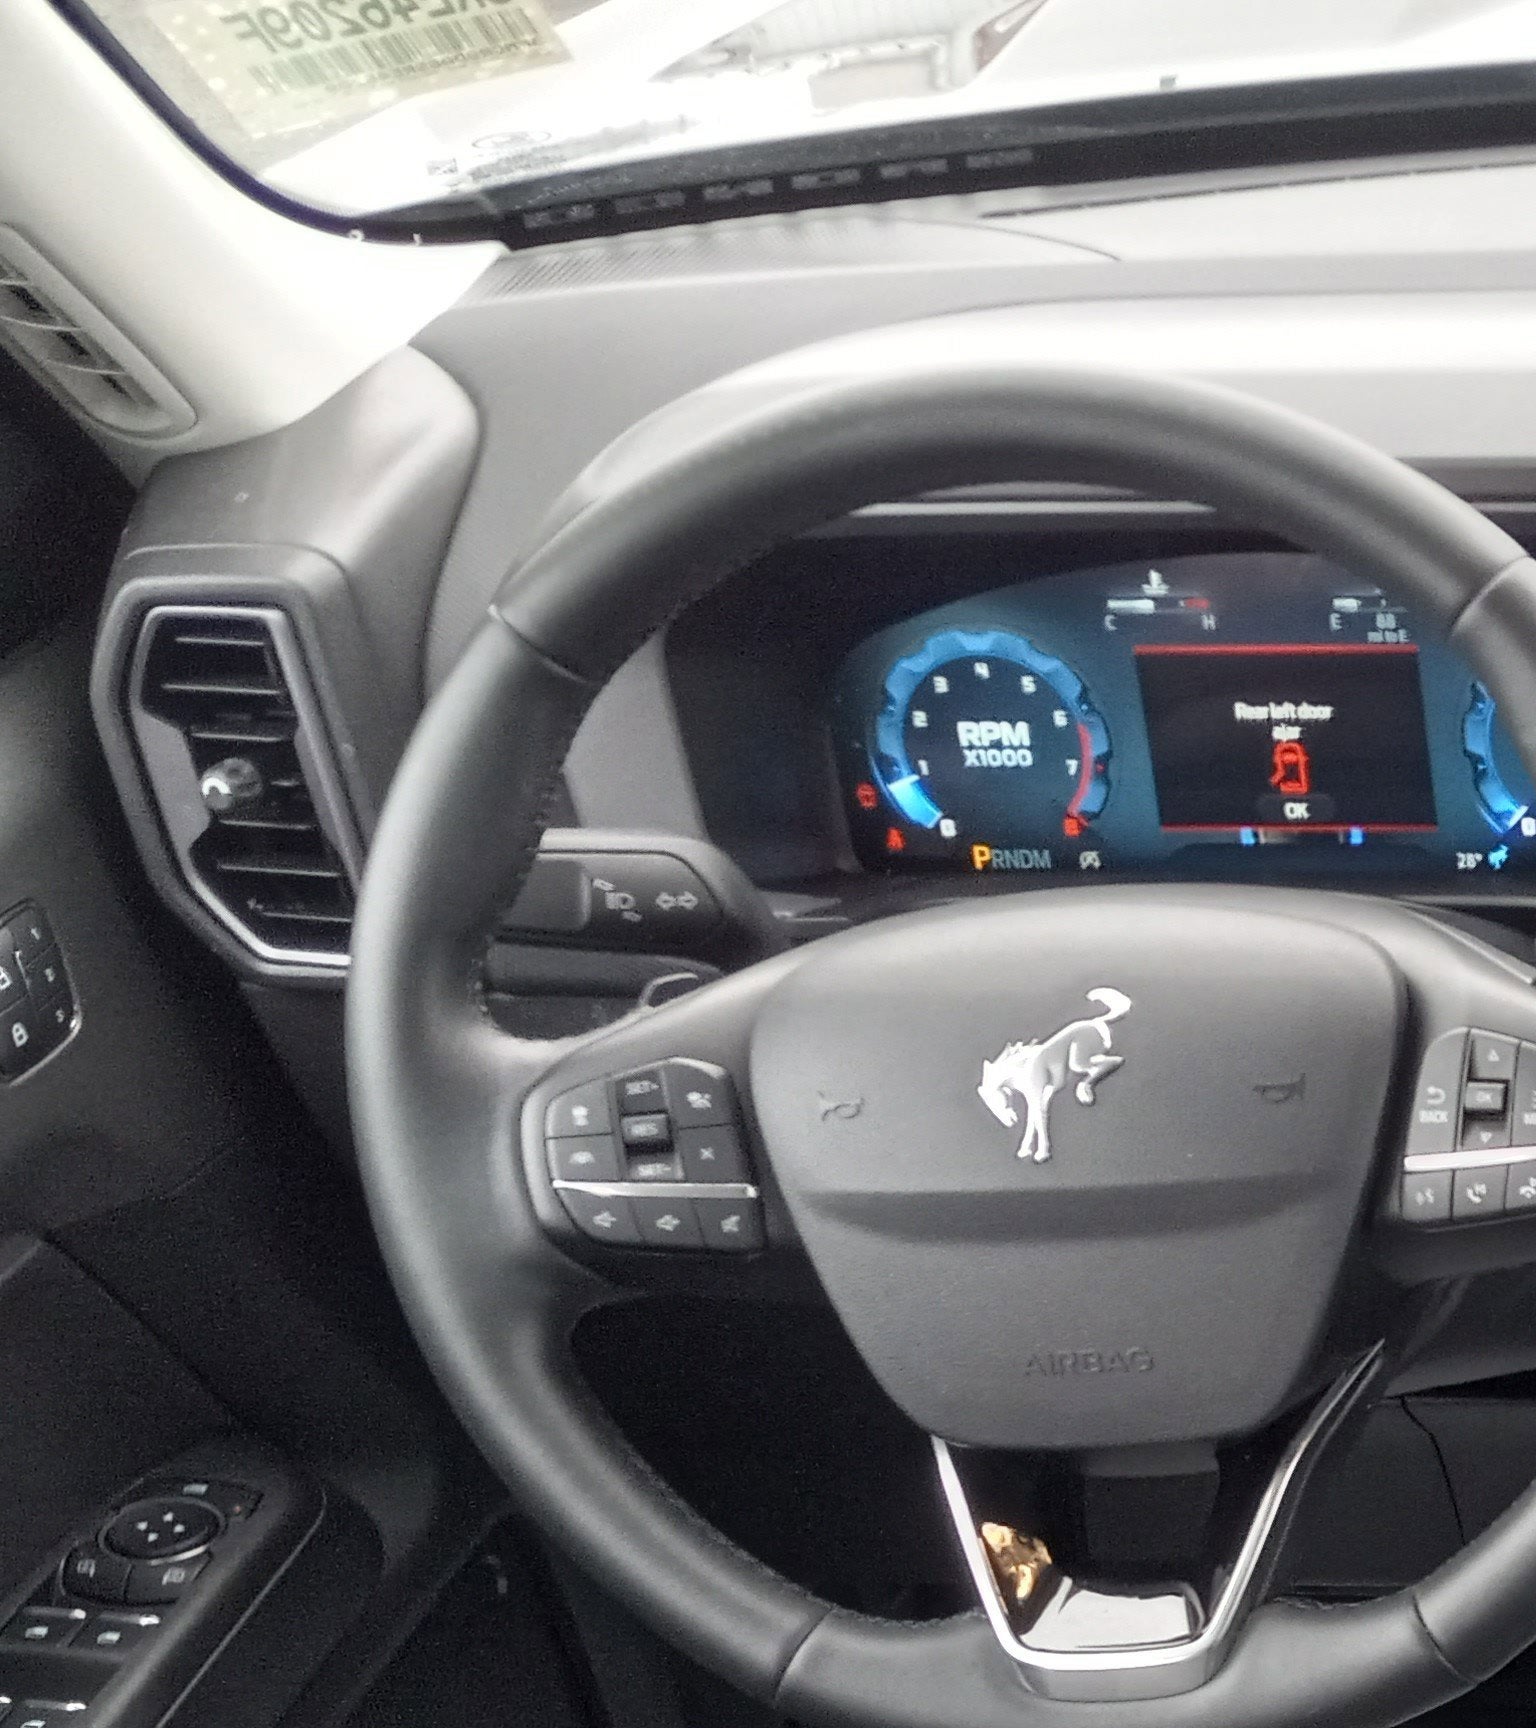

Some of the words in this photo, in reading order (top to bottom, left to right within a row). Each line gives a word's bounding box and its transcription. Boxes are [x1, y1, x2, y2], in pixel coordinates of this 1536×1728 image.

[1104, 614, 1117, 631] C
[1202, 614, 1216, 631] H
[1330, 613, 1343, 631] E
[974, 662, 990, 679] 4
[933, 676, 949, 693] 3
[1021, 675, 1036, 693] 5
[912, 711, 928, 727] 2
[1053, 710, 1068, 727] 6
[957, 721, 1030, 746] RPM
[963, 749, 1033, 767] X1000
[919, 760, 929, 775] 1
[1065, 759, 1078, 776] 7
[1284, 803, 1311, 819] OK
[1419, 1111, 1448, 1123] BACK
[1025, 1349, 1156, 1376] AIRBAG
